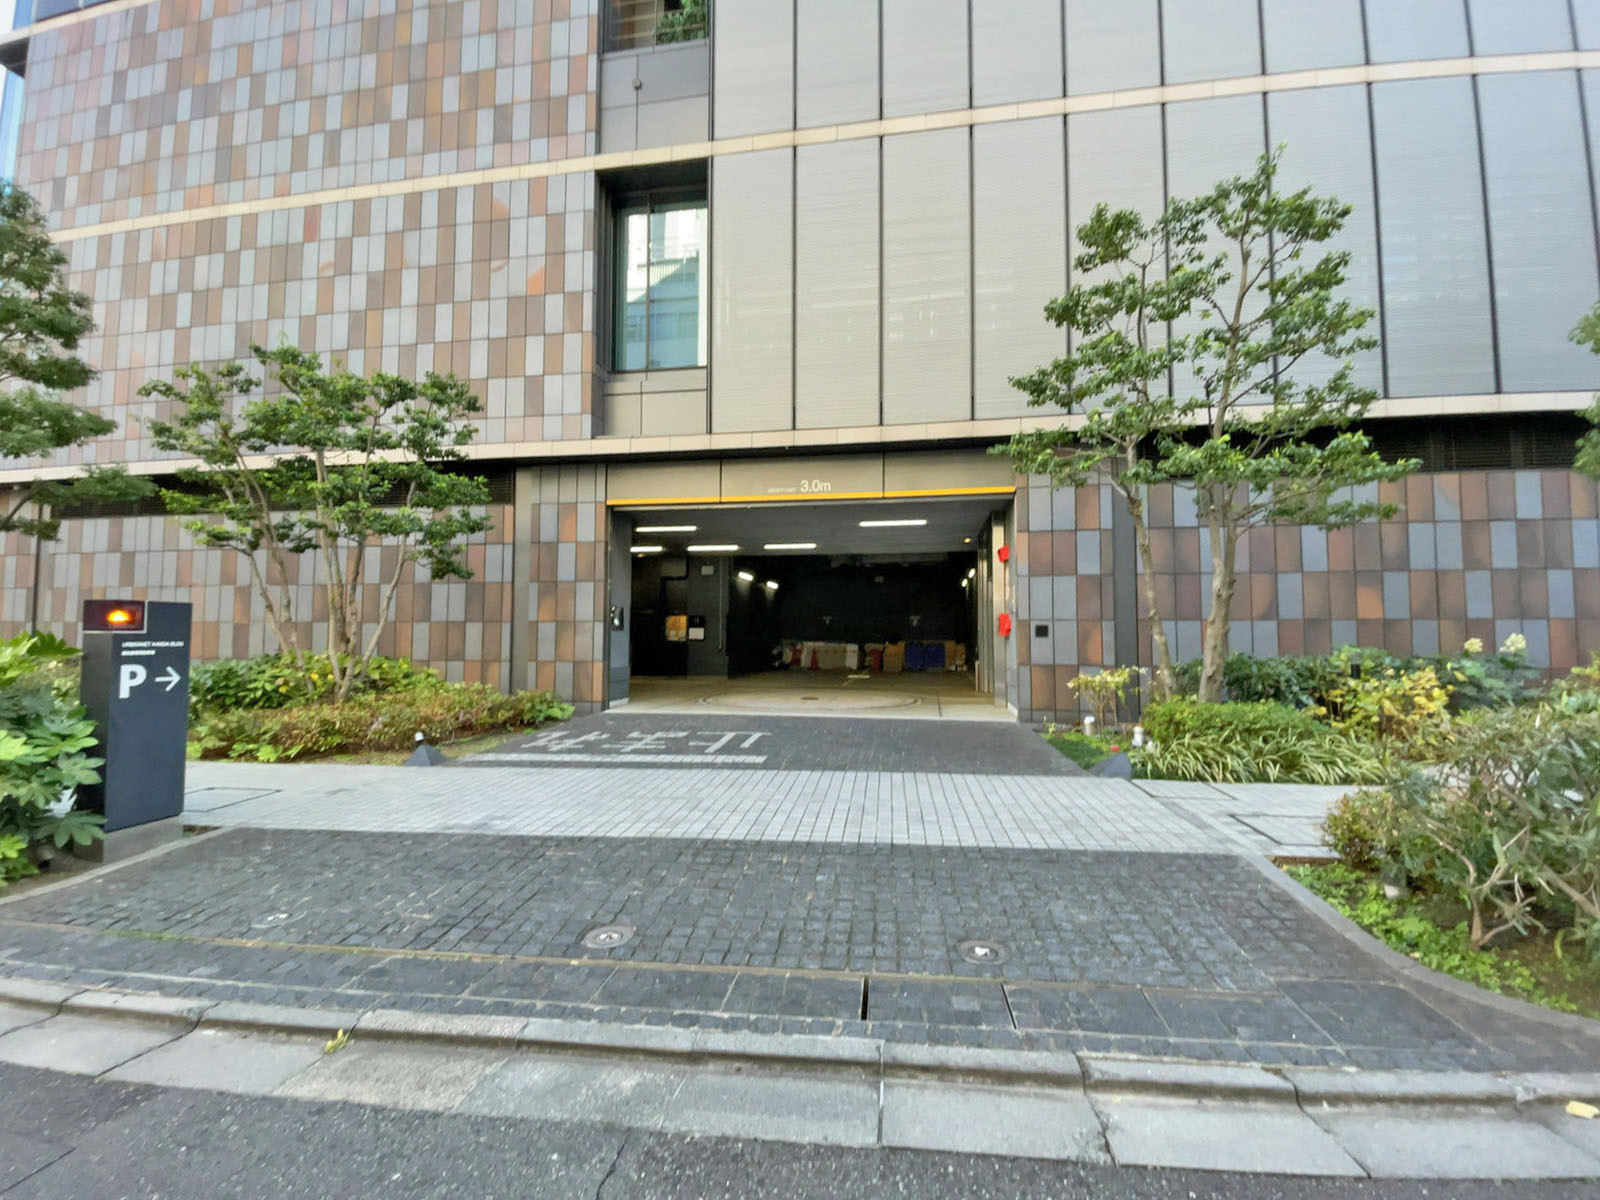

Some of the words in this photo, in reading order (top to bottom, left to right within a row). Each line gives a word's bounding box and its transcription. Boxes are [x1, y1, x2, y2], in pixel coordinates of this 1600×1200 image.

[800, 479, 832, 493] 3.0m
[118, 664, 147, 699] P
[520, 731, 772, 753] 止まれ
